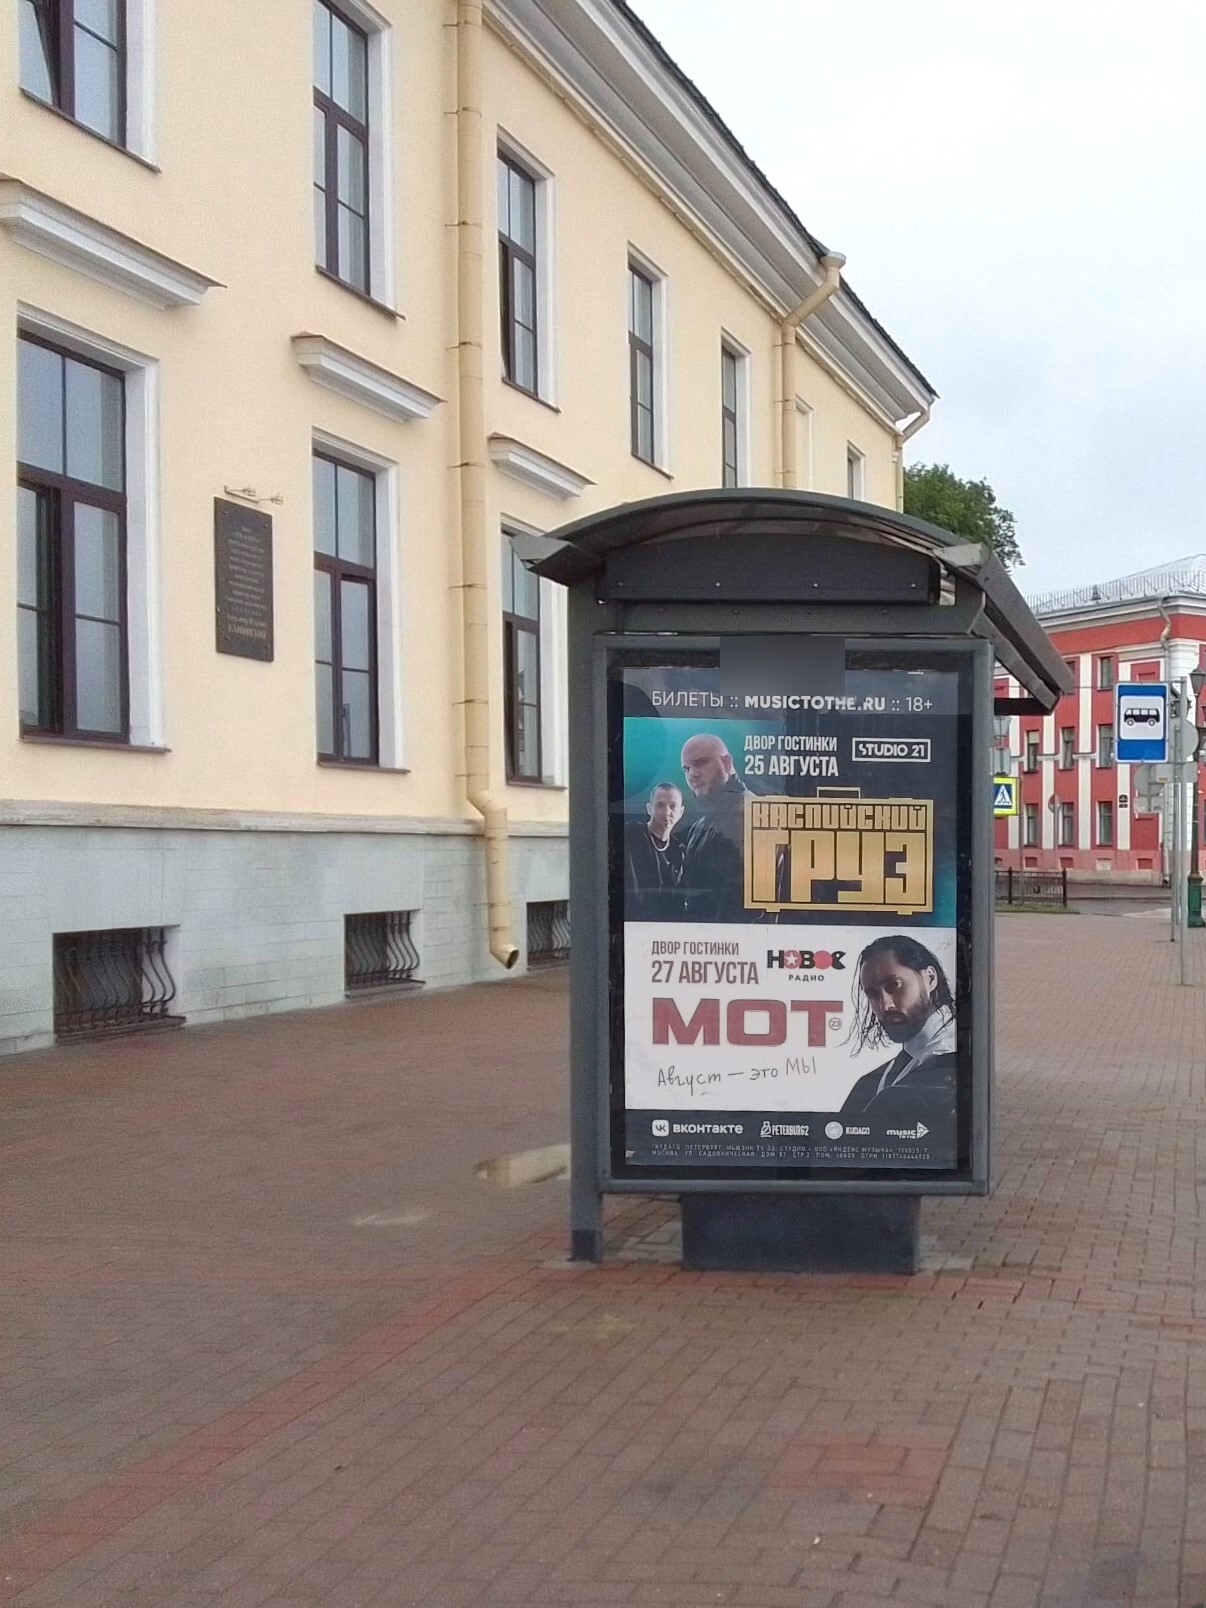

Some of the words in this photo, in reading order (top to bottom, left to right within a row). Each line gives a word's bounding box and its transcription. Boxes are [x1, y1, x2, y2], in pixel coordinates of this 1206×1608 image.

[652, 690, 724, 708] БИЛЕТЫ
[744, 695, 886, 711] MUSICTOTHE.RU
[906, 696, 933, 712] 18+
[744, 735, 775, 751] ДВОР
[778, 735, 838, 752] ГОСТИНКИ
[858, 743, 908, 757] STUDIO
[911, 744, 925, 757] 21
[744, 755, 765, 775] 25
[768, 755, 839, 777] АВГУСТА
[752, 802, 927, 831] КАСПИЙСКИЙ
[752, 830, 926, 905] ГРУЗ
[651, 940, 681, 956] ДВОР
[683, 941, 740, 956] ГОСТИНКИ
[651, 960, 675, 984] 27
[678, 961, 760, 985] АВГУСТА
[788, 974, 825, 982] РАДИО
[652, 997, 844, 1048] МОТ
[657, 1065, 722, 1097] Август
[749, 1067, 779, 1081] это
